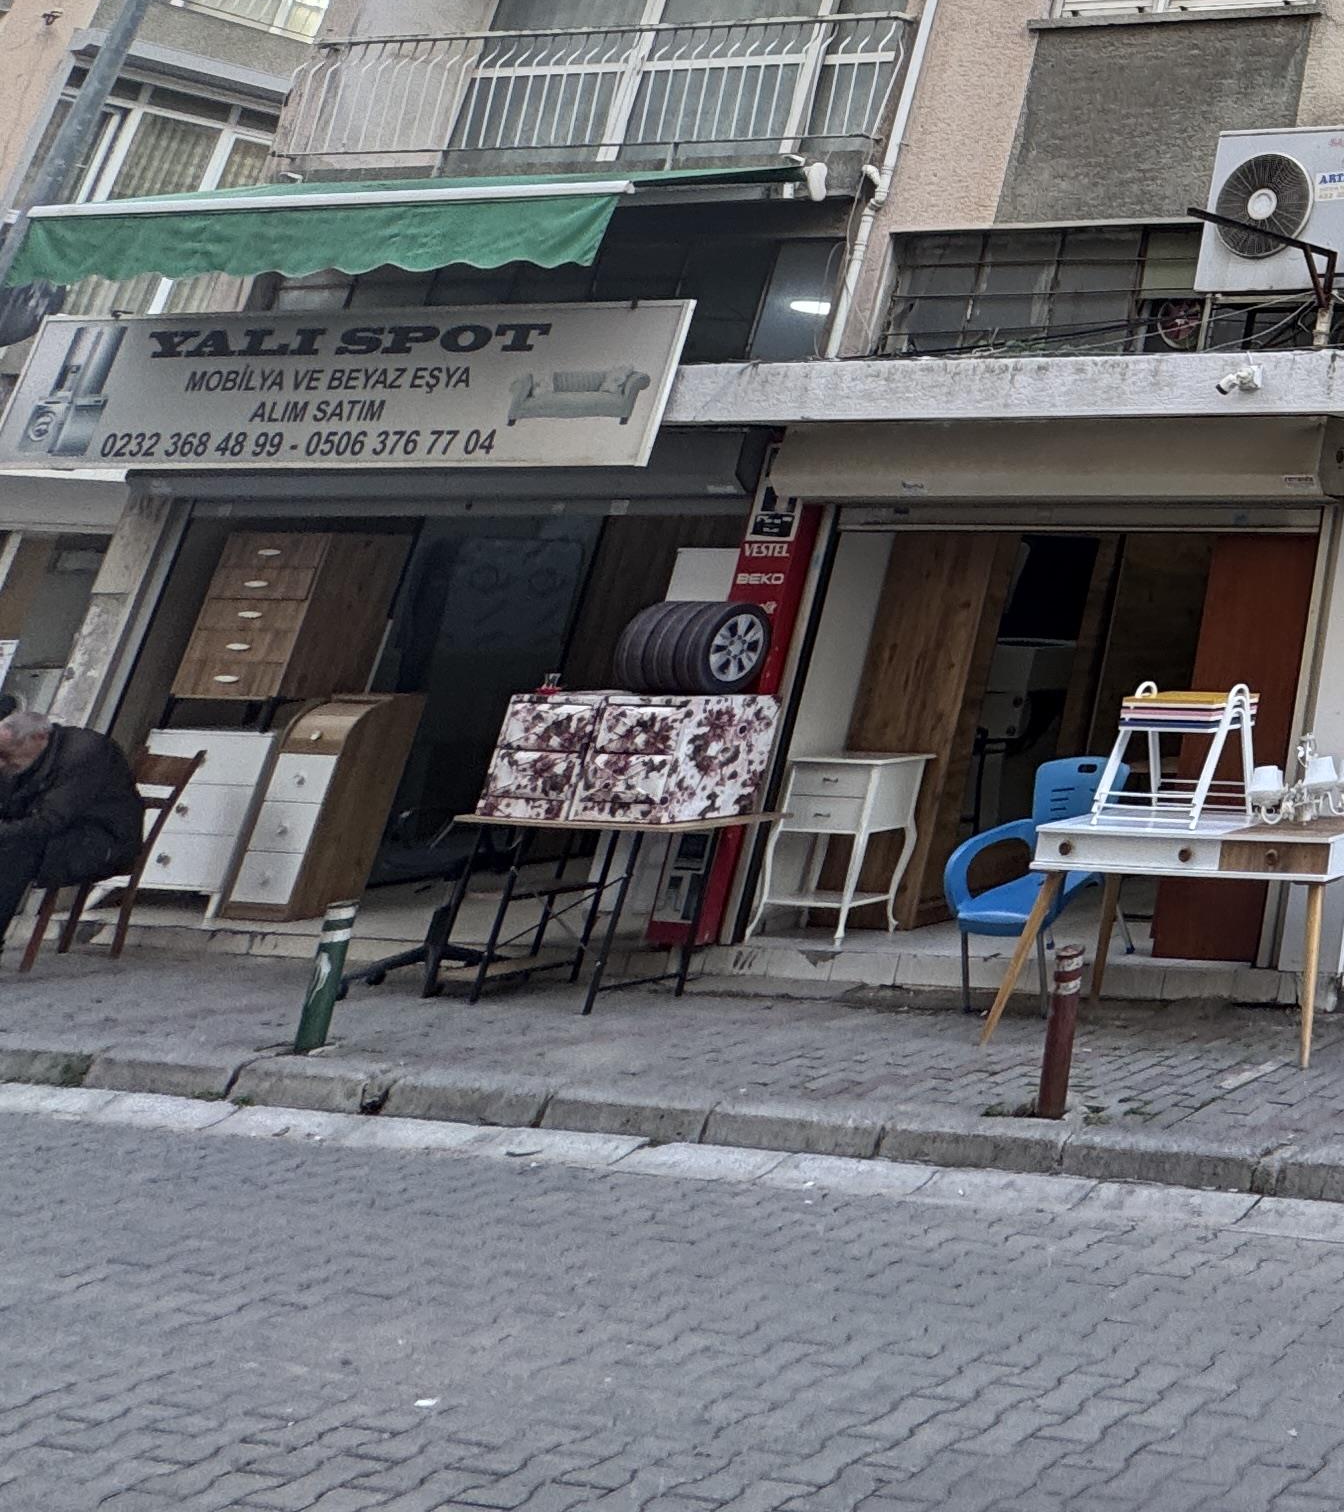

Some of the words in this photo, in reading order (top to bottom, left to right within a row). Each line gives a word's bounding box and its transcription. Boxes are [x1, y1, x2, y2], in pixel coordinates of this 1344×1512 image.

[148, 328, 329, 358] YALI
[335, 323, 552, 356] SPOT
[185, 363, 285, 392] MOBİLYA
[293, 369, 323, 390] VE
[328, 367, 406, 390] BEYAZ
[410, 366, 471, 394] EŞYA
[249, 400, 307, 423] ALIM
[312, 399, 385, 423] SATIM
[101, 433, 161, 458] 0232
[164, 433, 208, 458] 368
[215, 432, 247, 457] 48
[252, 432, 284, 457] 99
[305, 431, 364, 457] 0506
[372, 430, 417, 455] 376
[426, 429, 459, 455] 77
[464, 429, 495, 455] 04
[744, 543, 790, 557] VESTEL
[736, 573, 784, 585] BEKO
